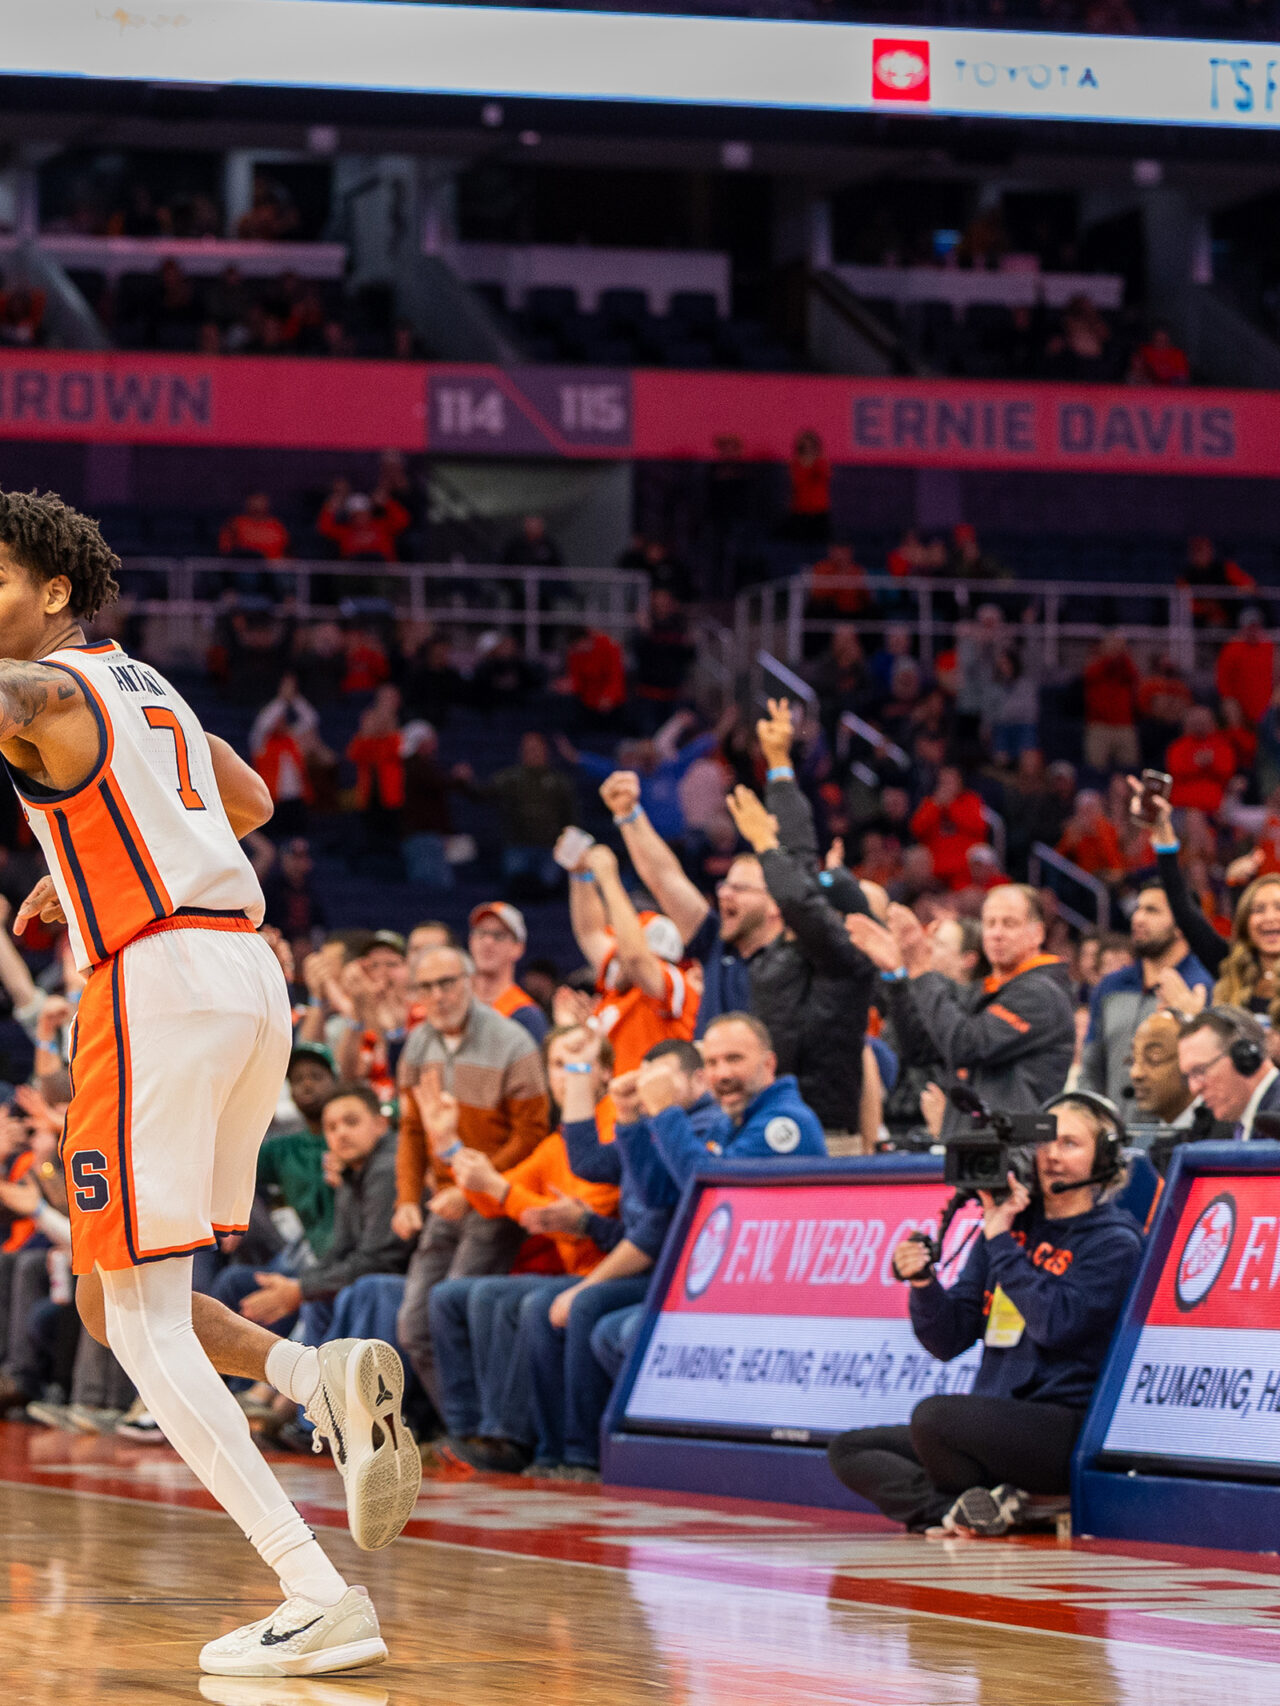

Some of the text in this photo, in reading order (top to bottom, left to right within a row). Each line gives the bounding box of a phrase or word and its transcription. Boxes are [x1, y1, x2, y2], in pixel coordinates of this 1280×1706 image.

[953, 58, 1099, 91] TOYOTA
[438, 385, 505, 436] 114
[852, 398, 1238, 459] ERNIE DAVIS
[141, 705, 207, 811] 7
[70, 1149, 111, 1213] S
[783, 1218, 886, 1286] WEBB
[1131, 1364, 1253, 1418] PLUMBING,
